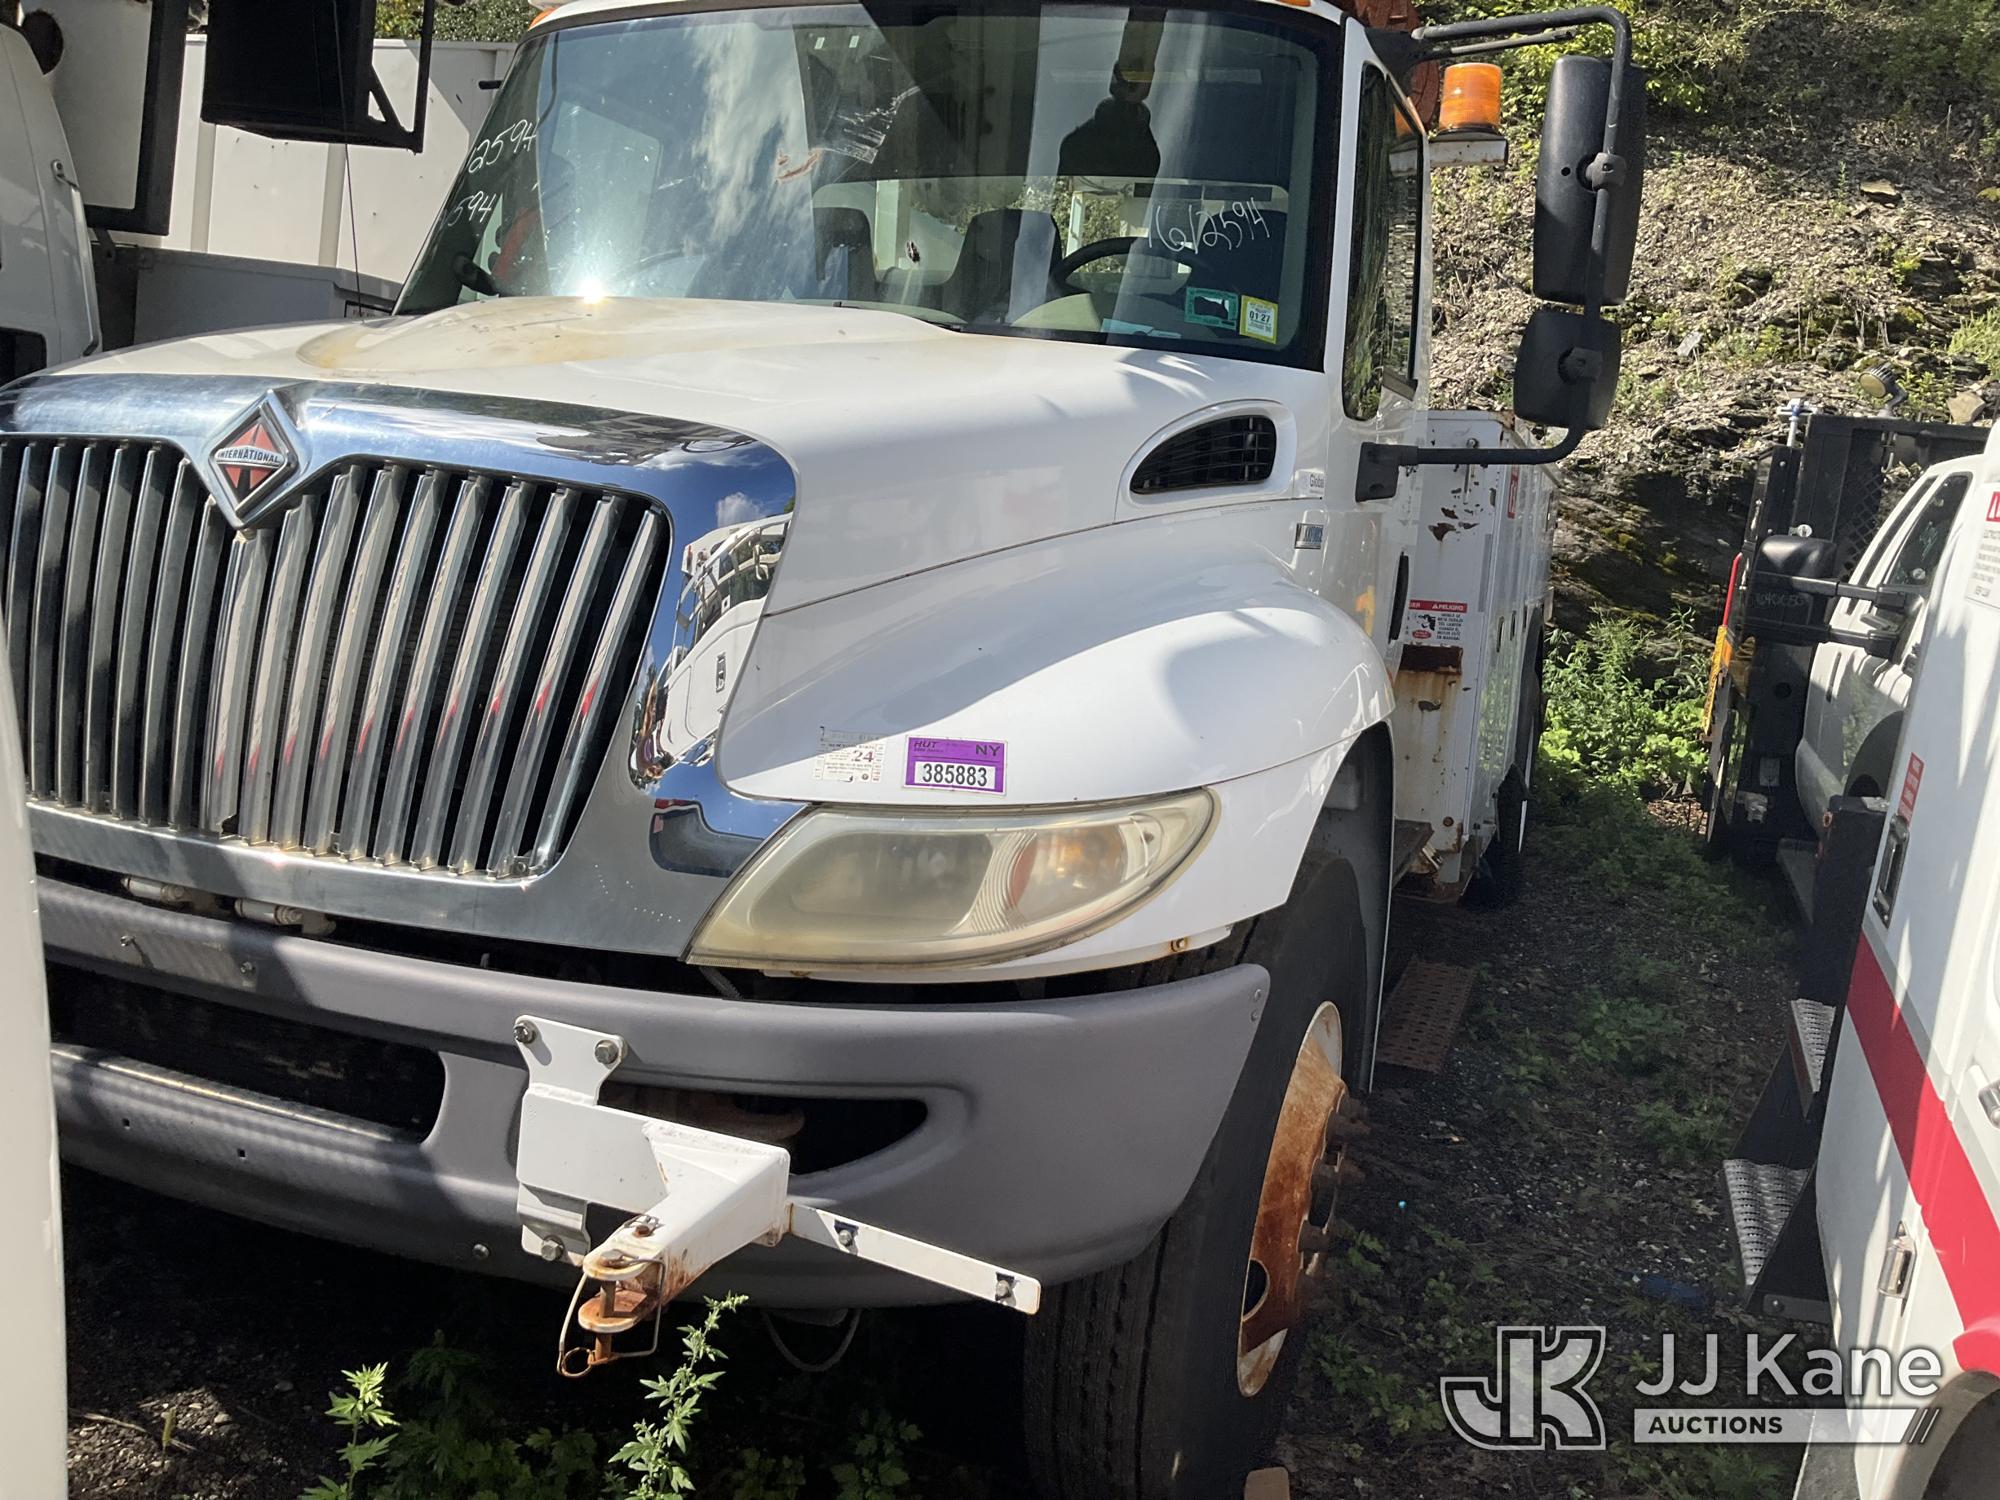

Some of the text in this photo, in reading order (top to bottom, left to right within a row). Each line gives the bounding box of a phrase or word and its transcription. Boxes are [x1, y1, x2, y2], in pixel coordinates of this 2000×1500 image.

[217, 449, 280, 463] INTERNATIONAL
[852, 749, 875, 762] 24
[914, 741, 1001, 757] HUT NY
[922, 763, 988, 787] 385883
